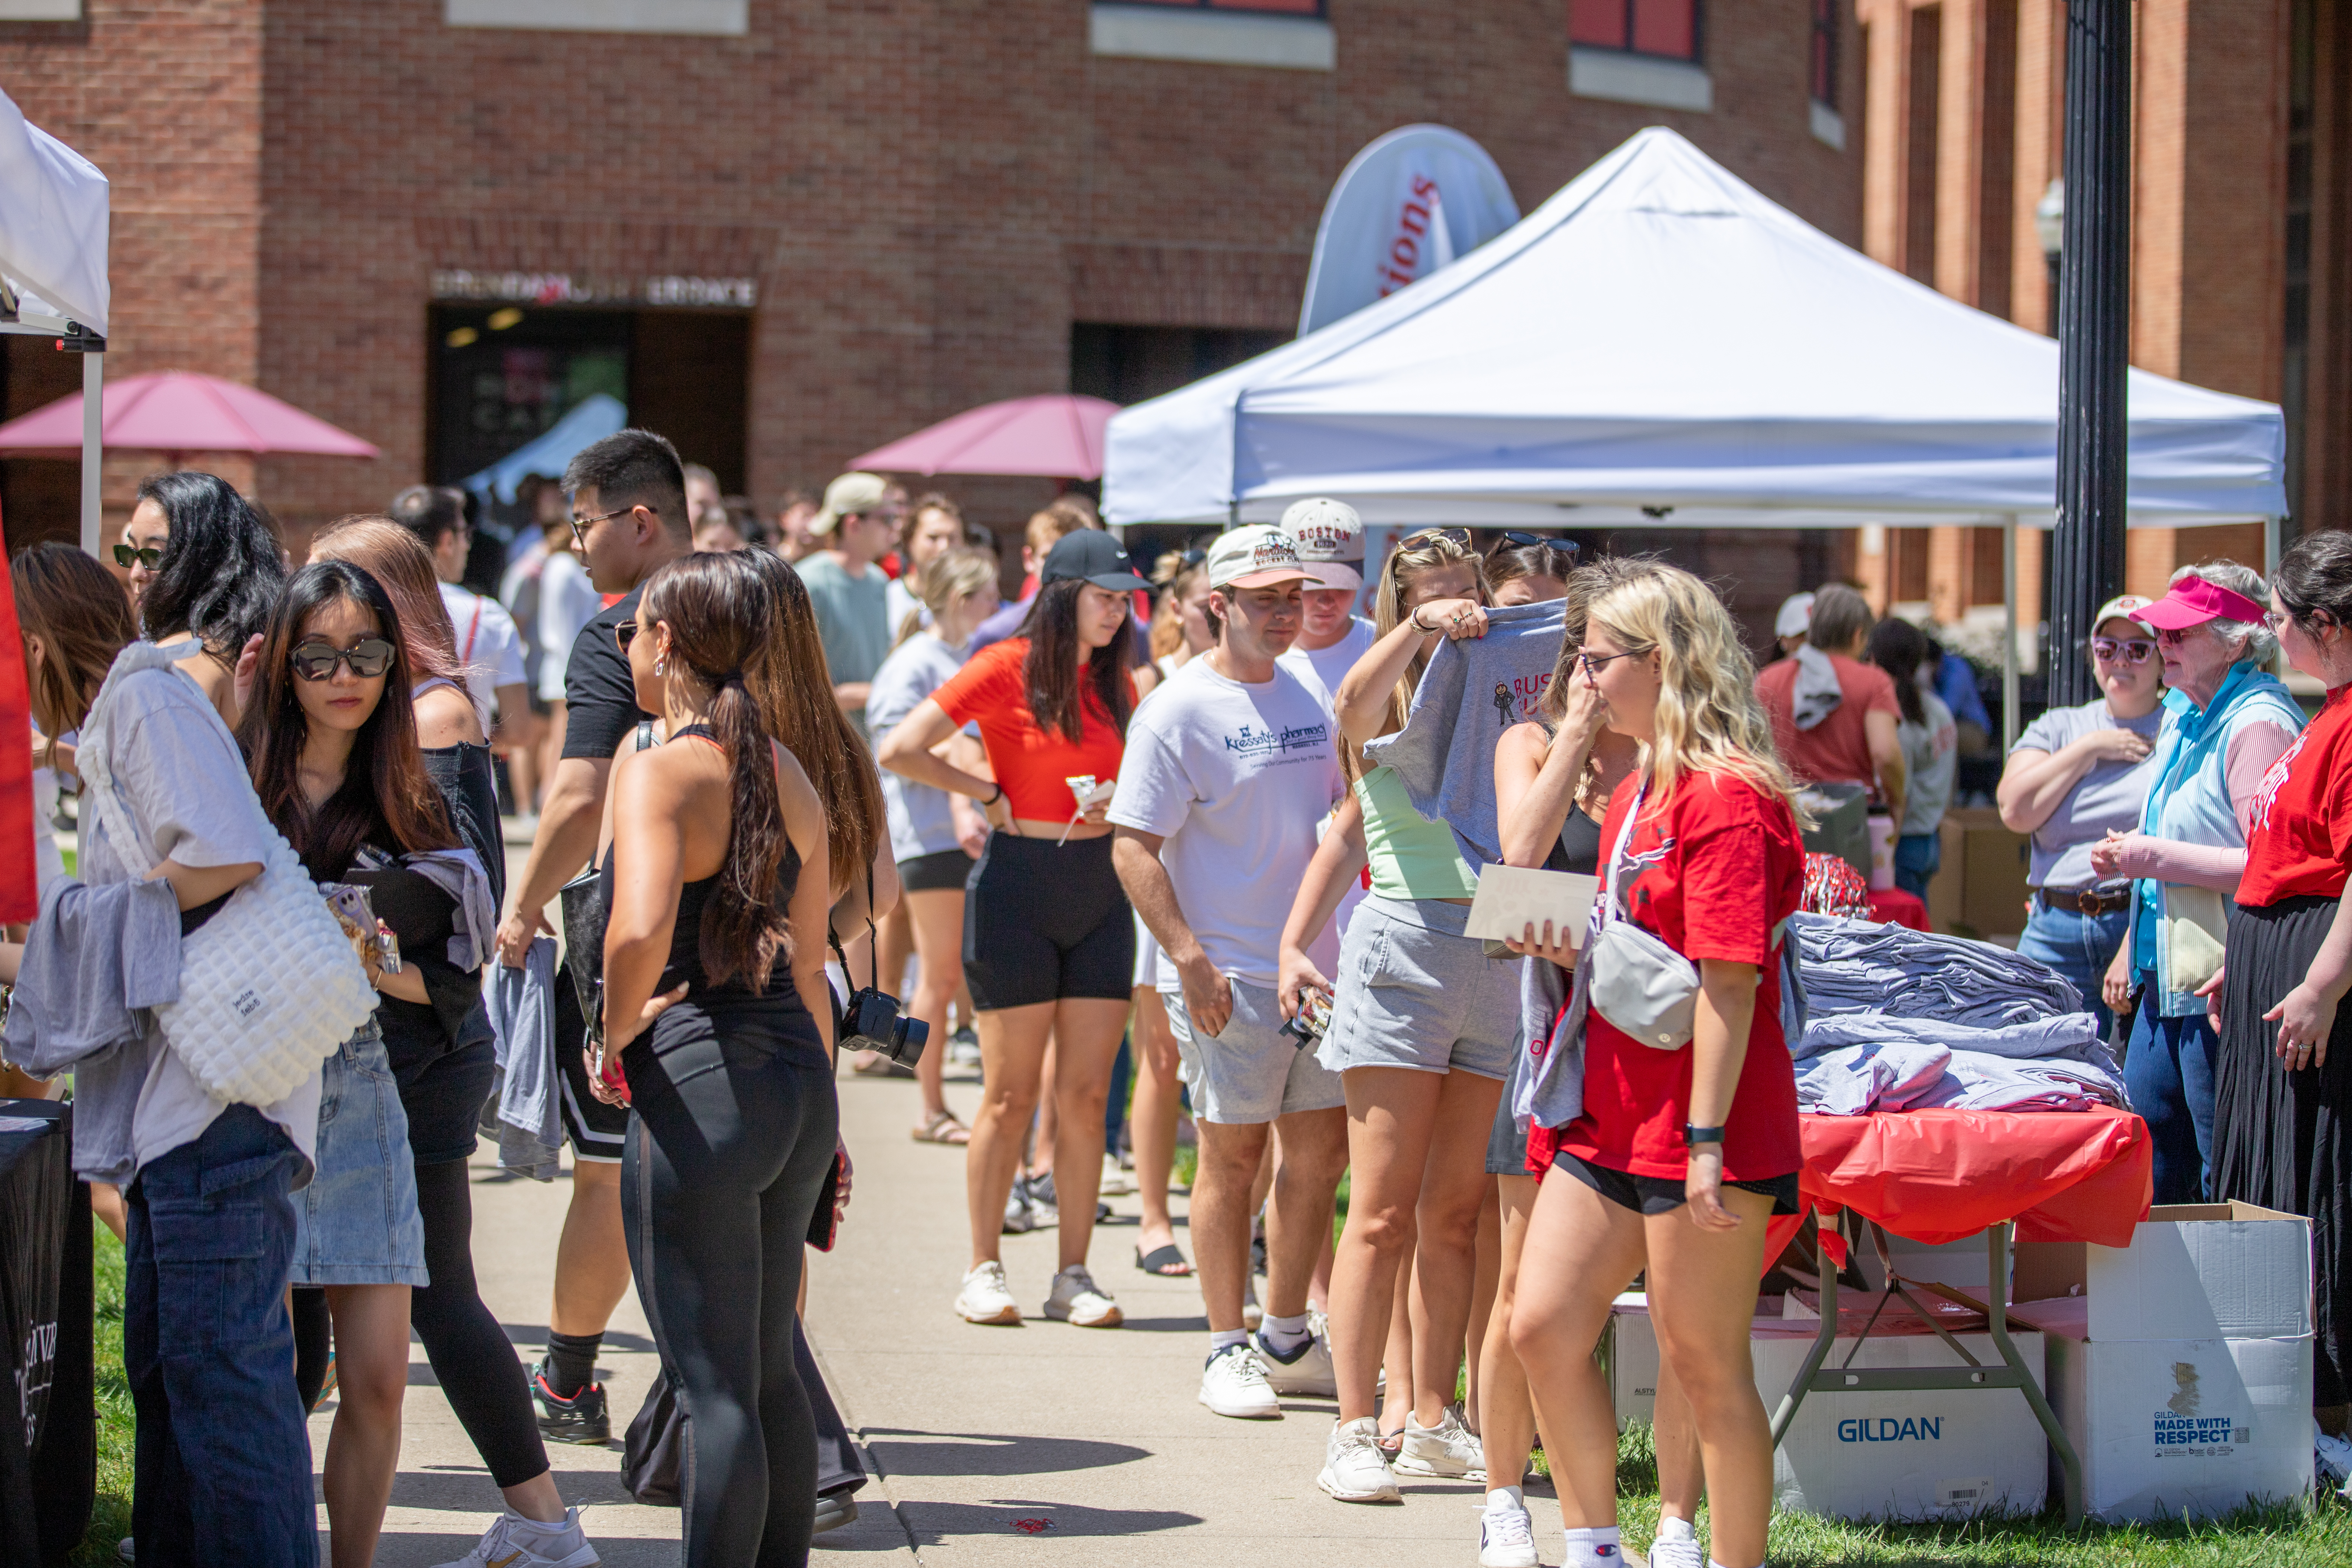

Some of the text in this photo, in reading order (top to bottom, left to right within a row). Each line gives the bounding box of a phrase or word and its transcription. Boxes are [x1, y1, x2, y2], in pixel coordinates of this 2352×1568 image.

[1298, 525, 1351, 542] BOSTON
[1256, 556, 1285, 567] HOCKEY
[2154, 1417, 2231, 1430] MADE WITH
